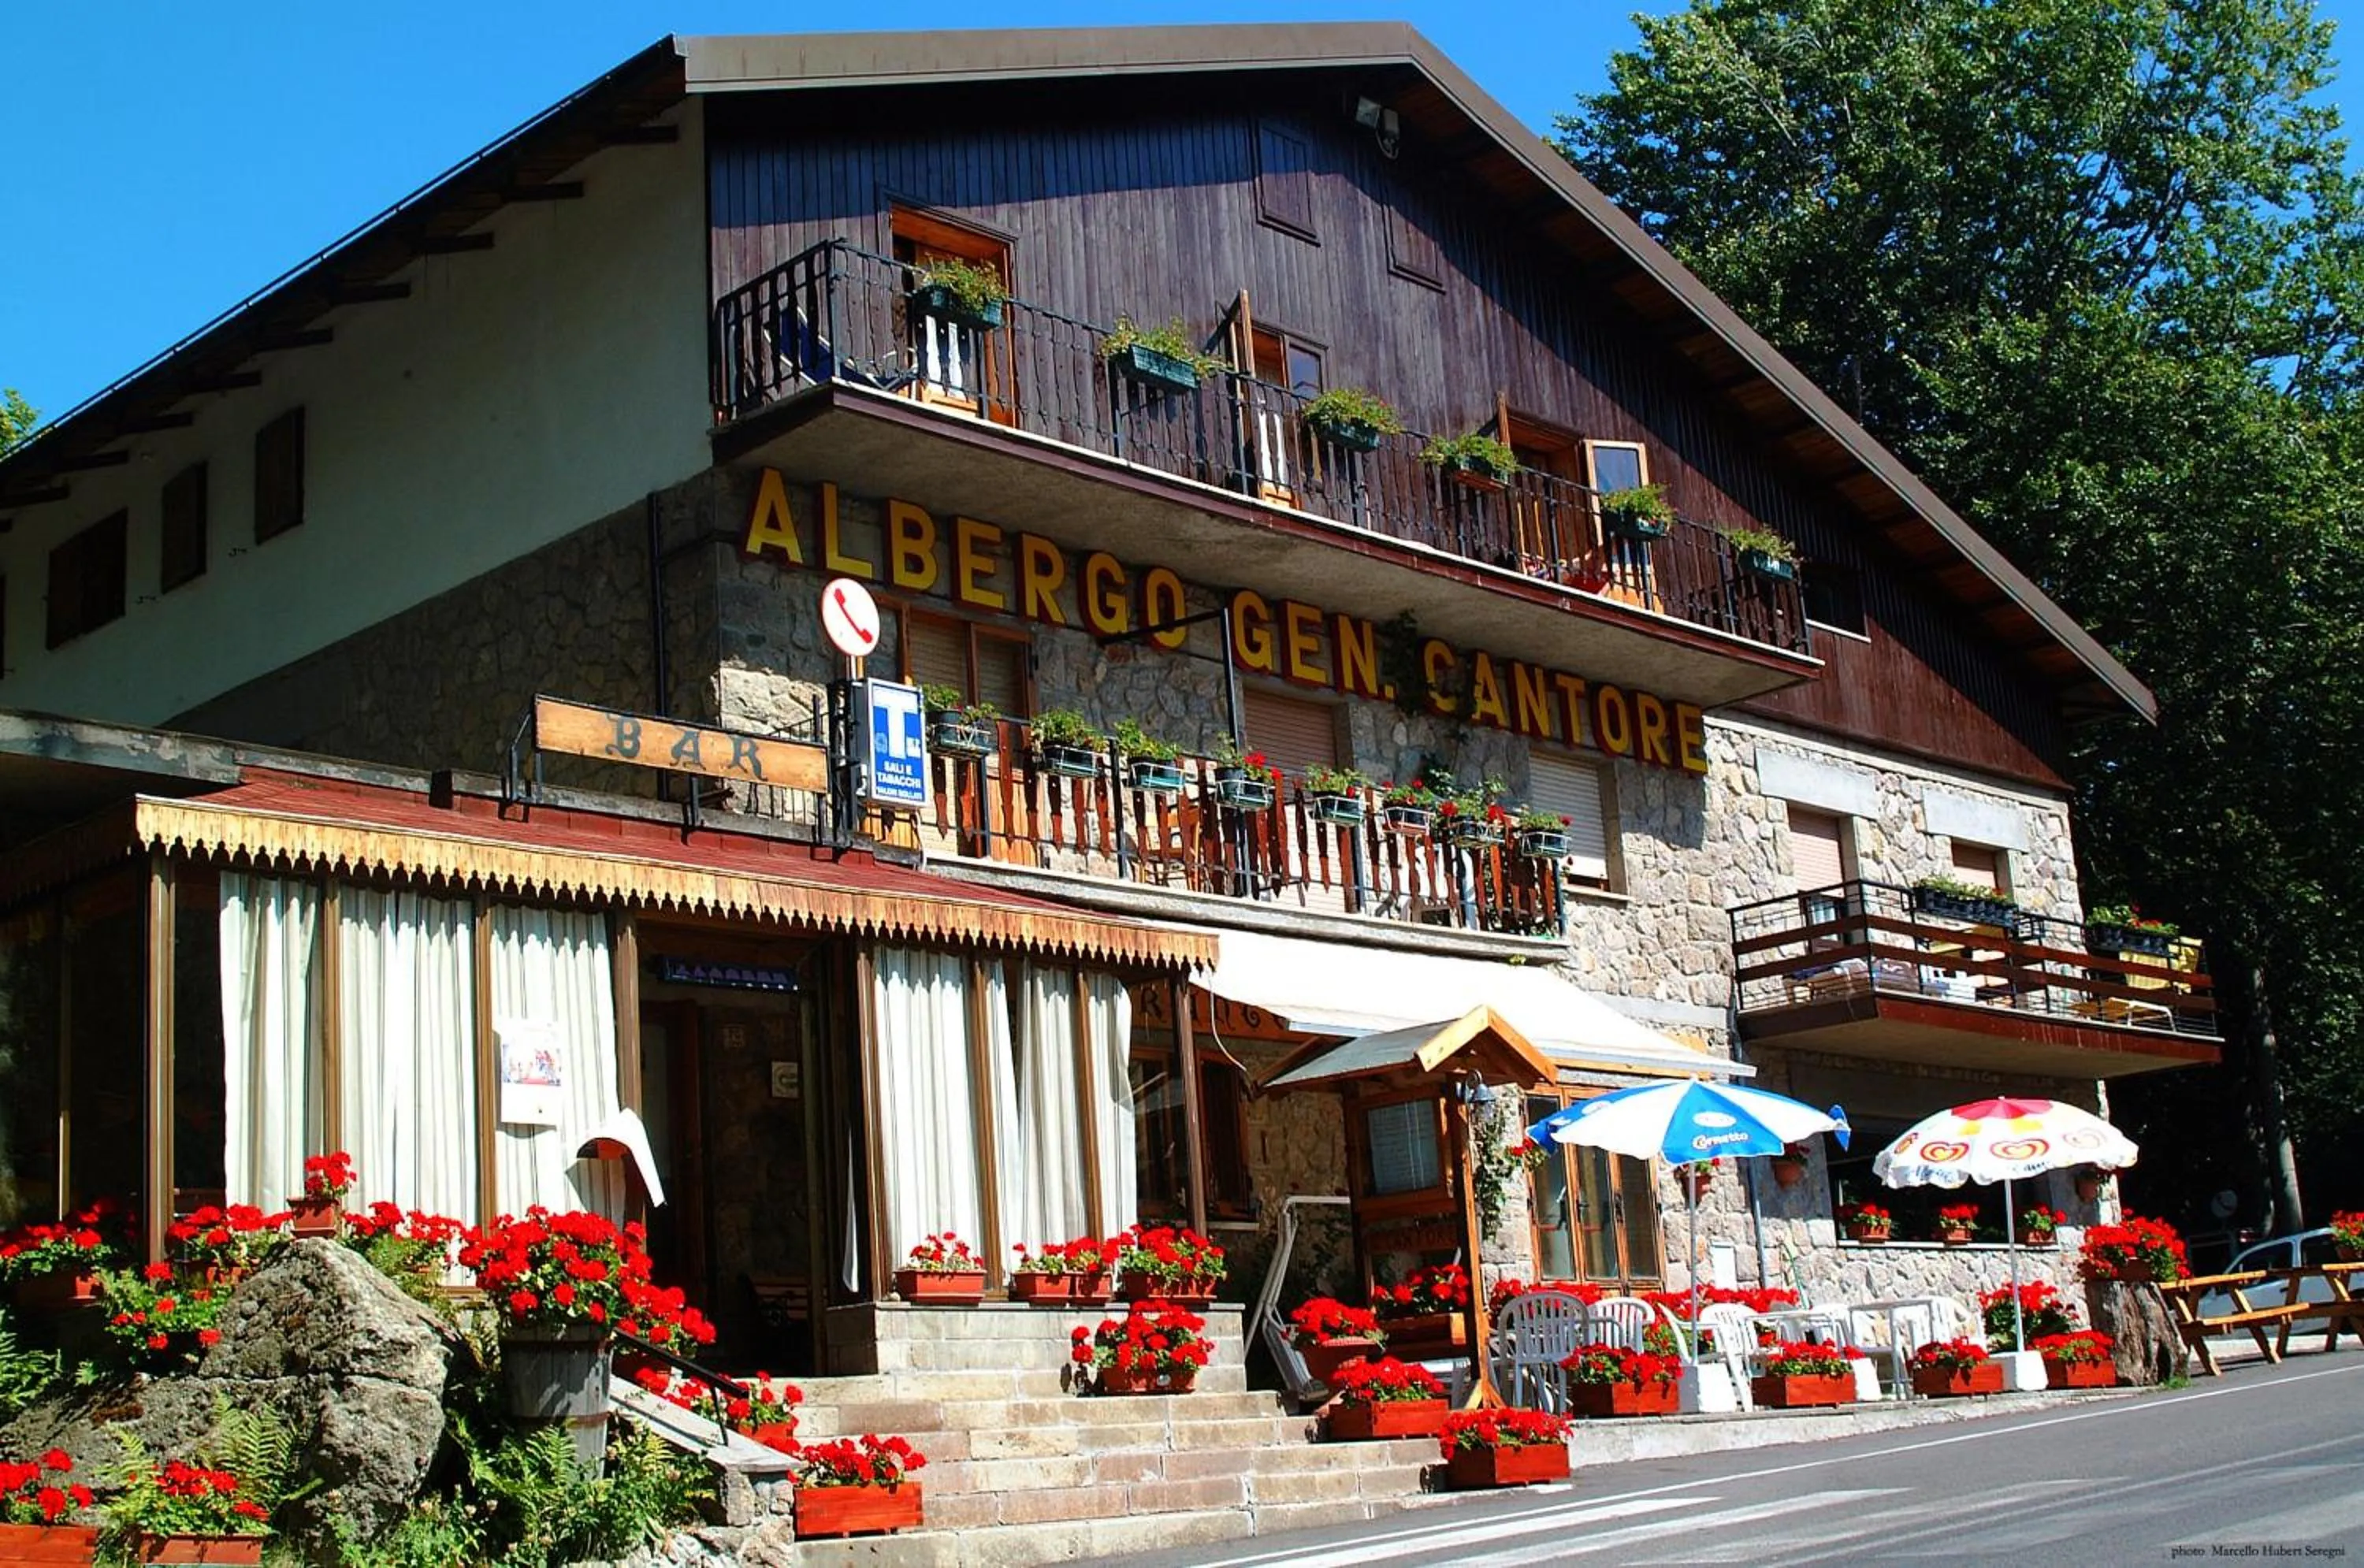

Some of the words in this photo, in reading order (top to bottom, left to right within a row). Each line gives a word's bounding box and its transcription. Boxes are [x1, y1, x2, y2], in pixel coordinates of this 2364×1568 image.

[742, 466, 1188, 652] ALBERGO
[1229, 589, 1396, 701] GEN.
[1421, 637, 1708, 775] CANTORE
[604, 712, 768, 782] BAR
[883, 760, 905, 774] SALI
[905, 764, 913, 777] E
[876, 771, 921, 789] TABACCHI
